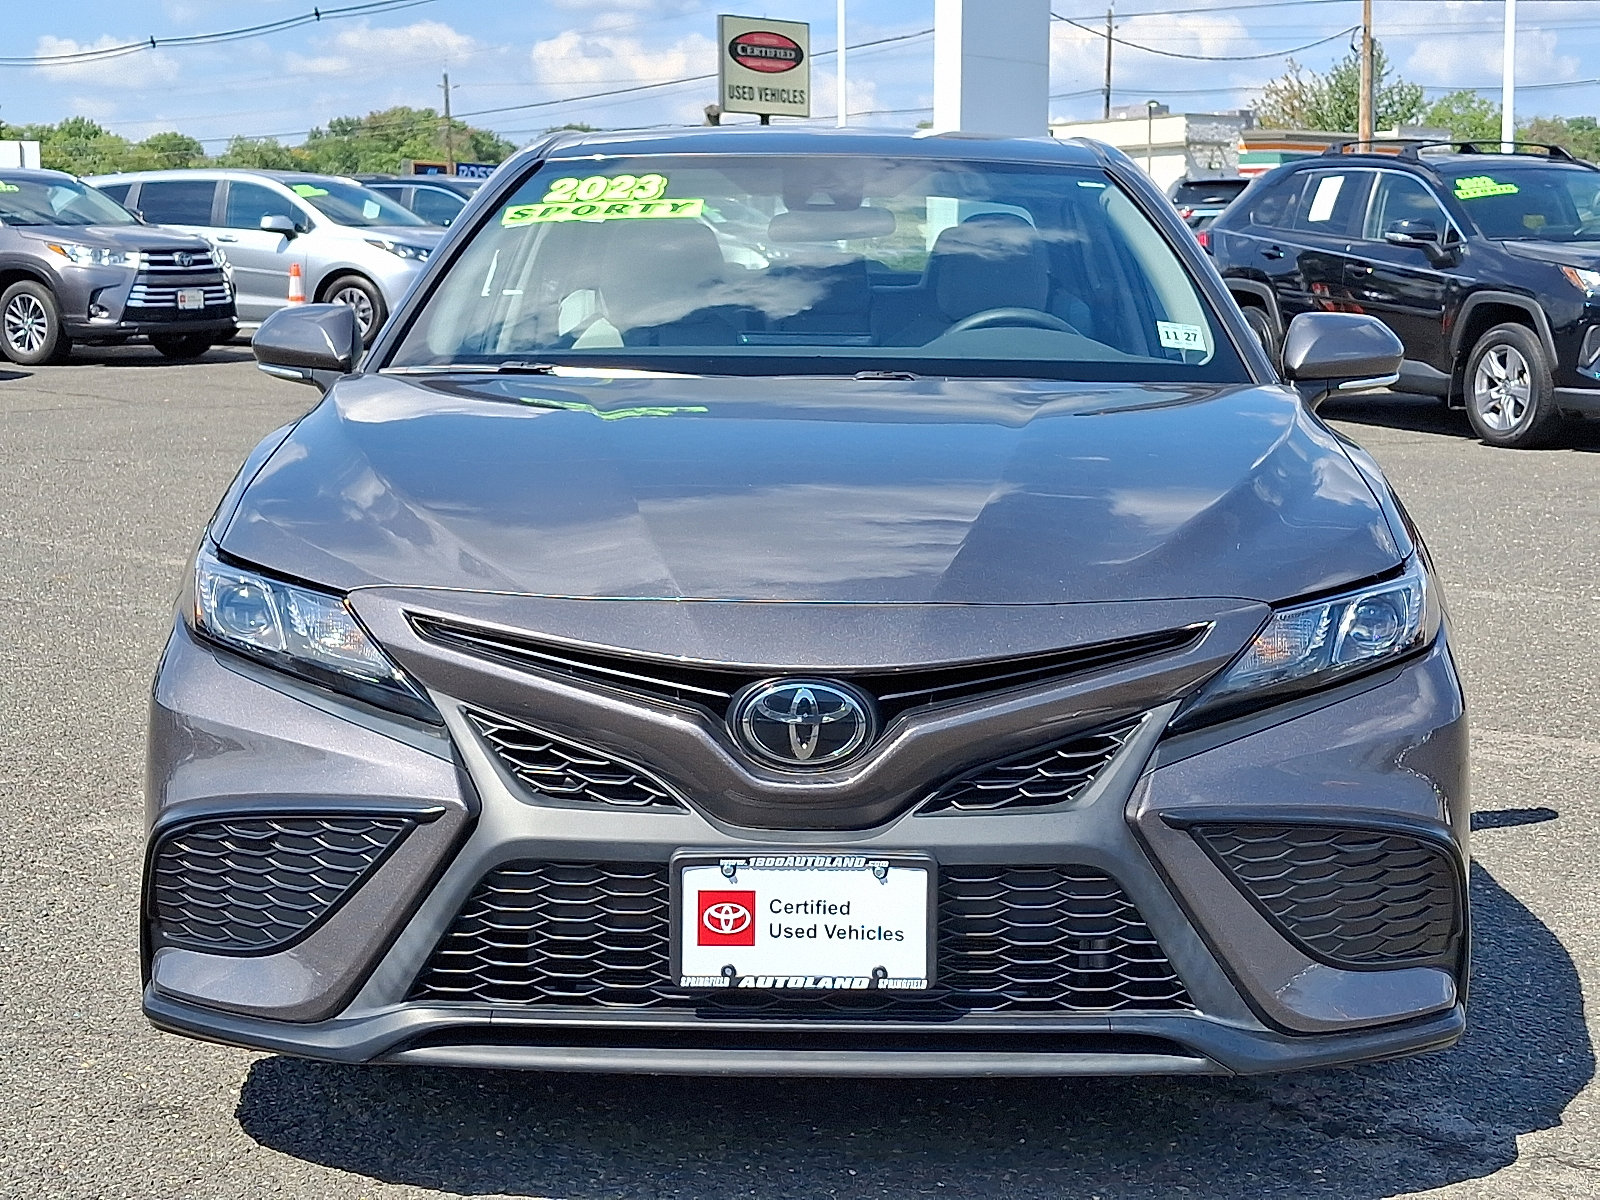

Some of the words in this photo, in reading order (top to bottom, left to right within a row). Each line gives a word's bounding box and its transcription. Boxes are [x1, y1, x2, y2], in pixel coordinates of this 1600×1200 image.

[737, 44, 796, 60] CERTIFIED
[728, 85, 754, 101] USED
[757, 87, 805, 104] VEHICLES
[542, 173, 668, 203] 2023
[508, 202, 697, 220] SPORTY
[1165, 331, 1179, 341] 11
[1184, 332, 1197, 342] 27
[769, 899, 850, 915] Certified
[769, 923, 817, 939] Used
[825, 925, 905, 942] Vehicles
[737, 976, 870, 990] AUTOLAND
